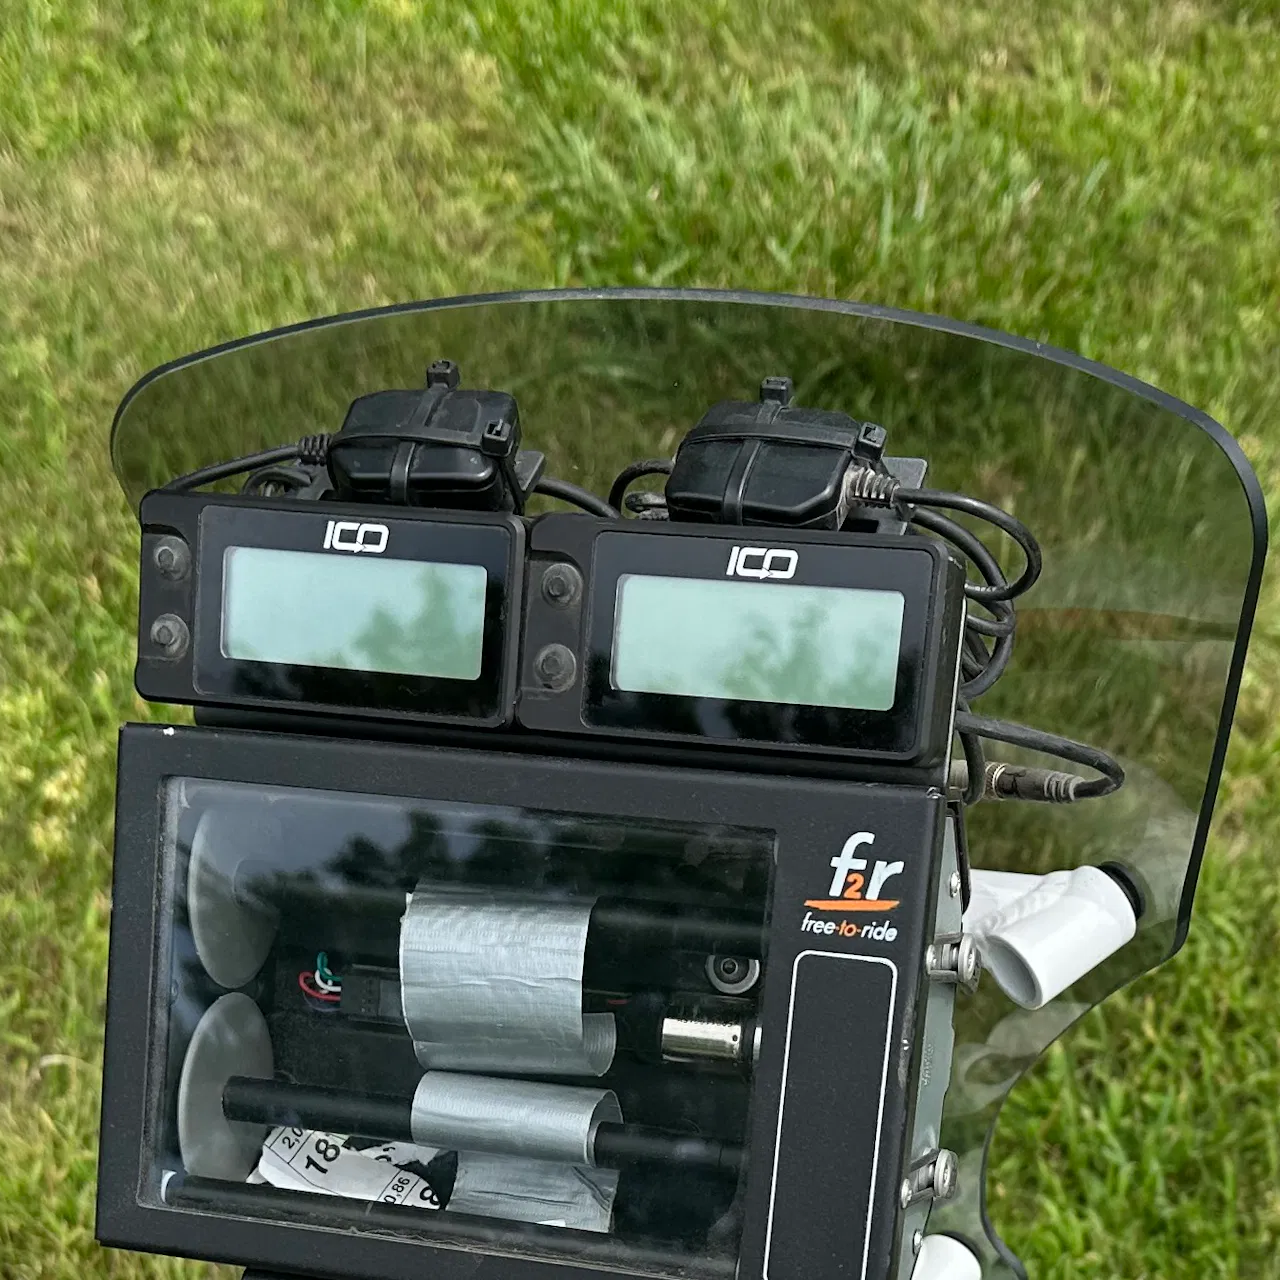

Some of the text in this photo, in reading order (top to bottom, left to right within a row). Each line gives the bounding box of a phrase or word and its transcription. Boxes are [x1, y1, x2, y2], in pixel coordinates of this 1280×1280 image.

[323, 520, 389, 553] ICO
[726, 545, 799, 579] ICO
[800, 911, 899, 942] free-to-ride
[305, 1138, 341, 1175] 18
